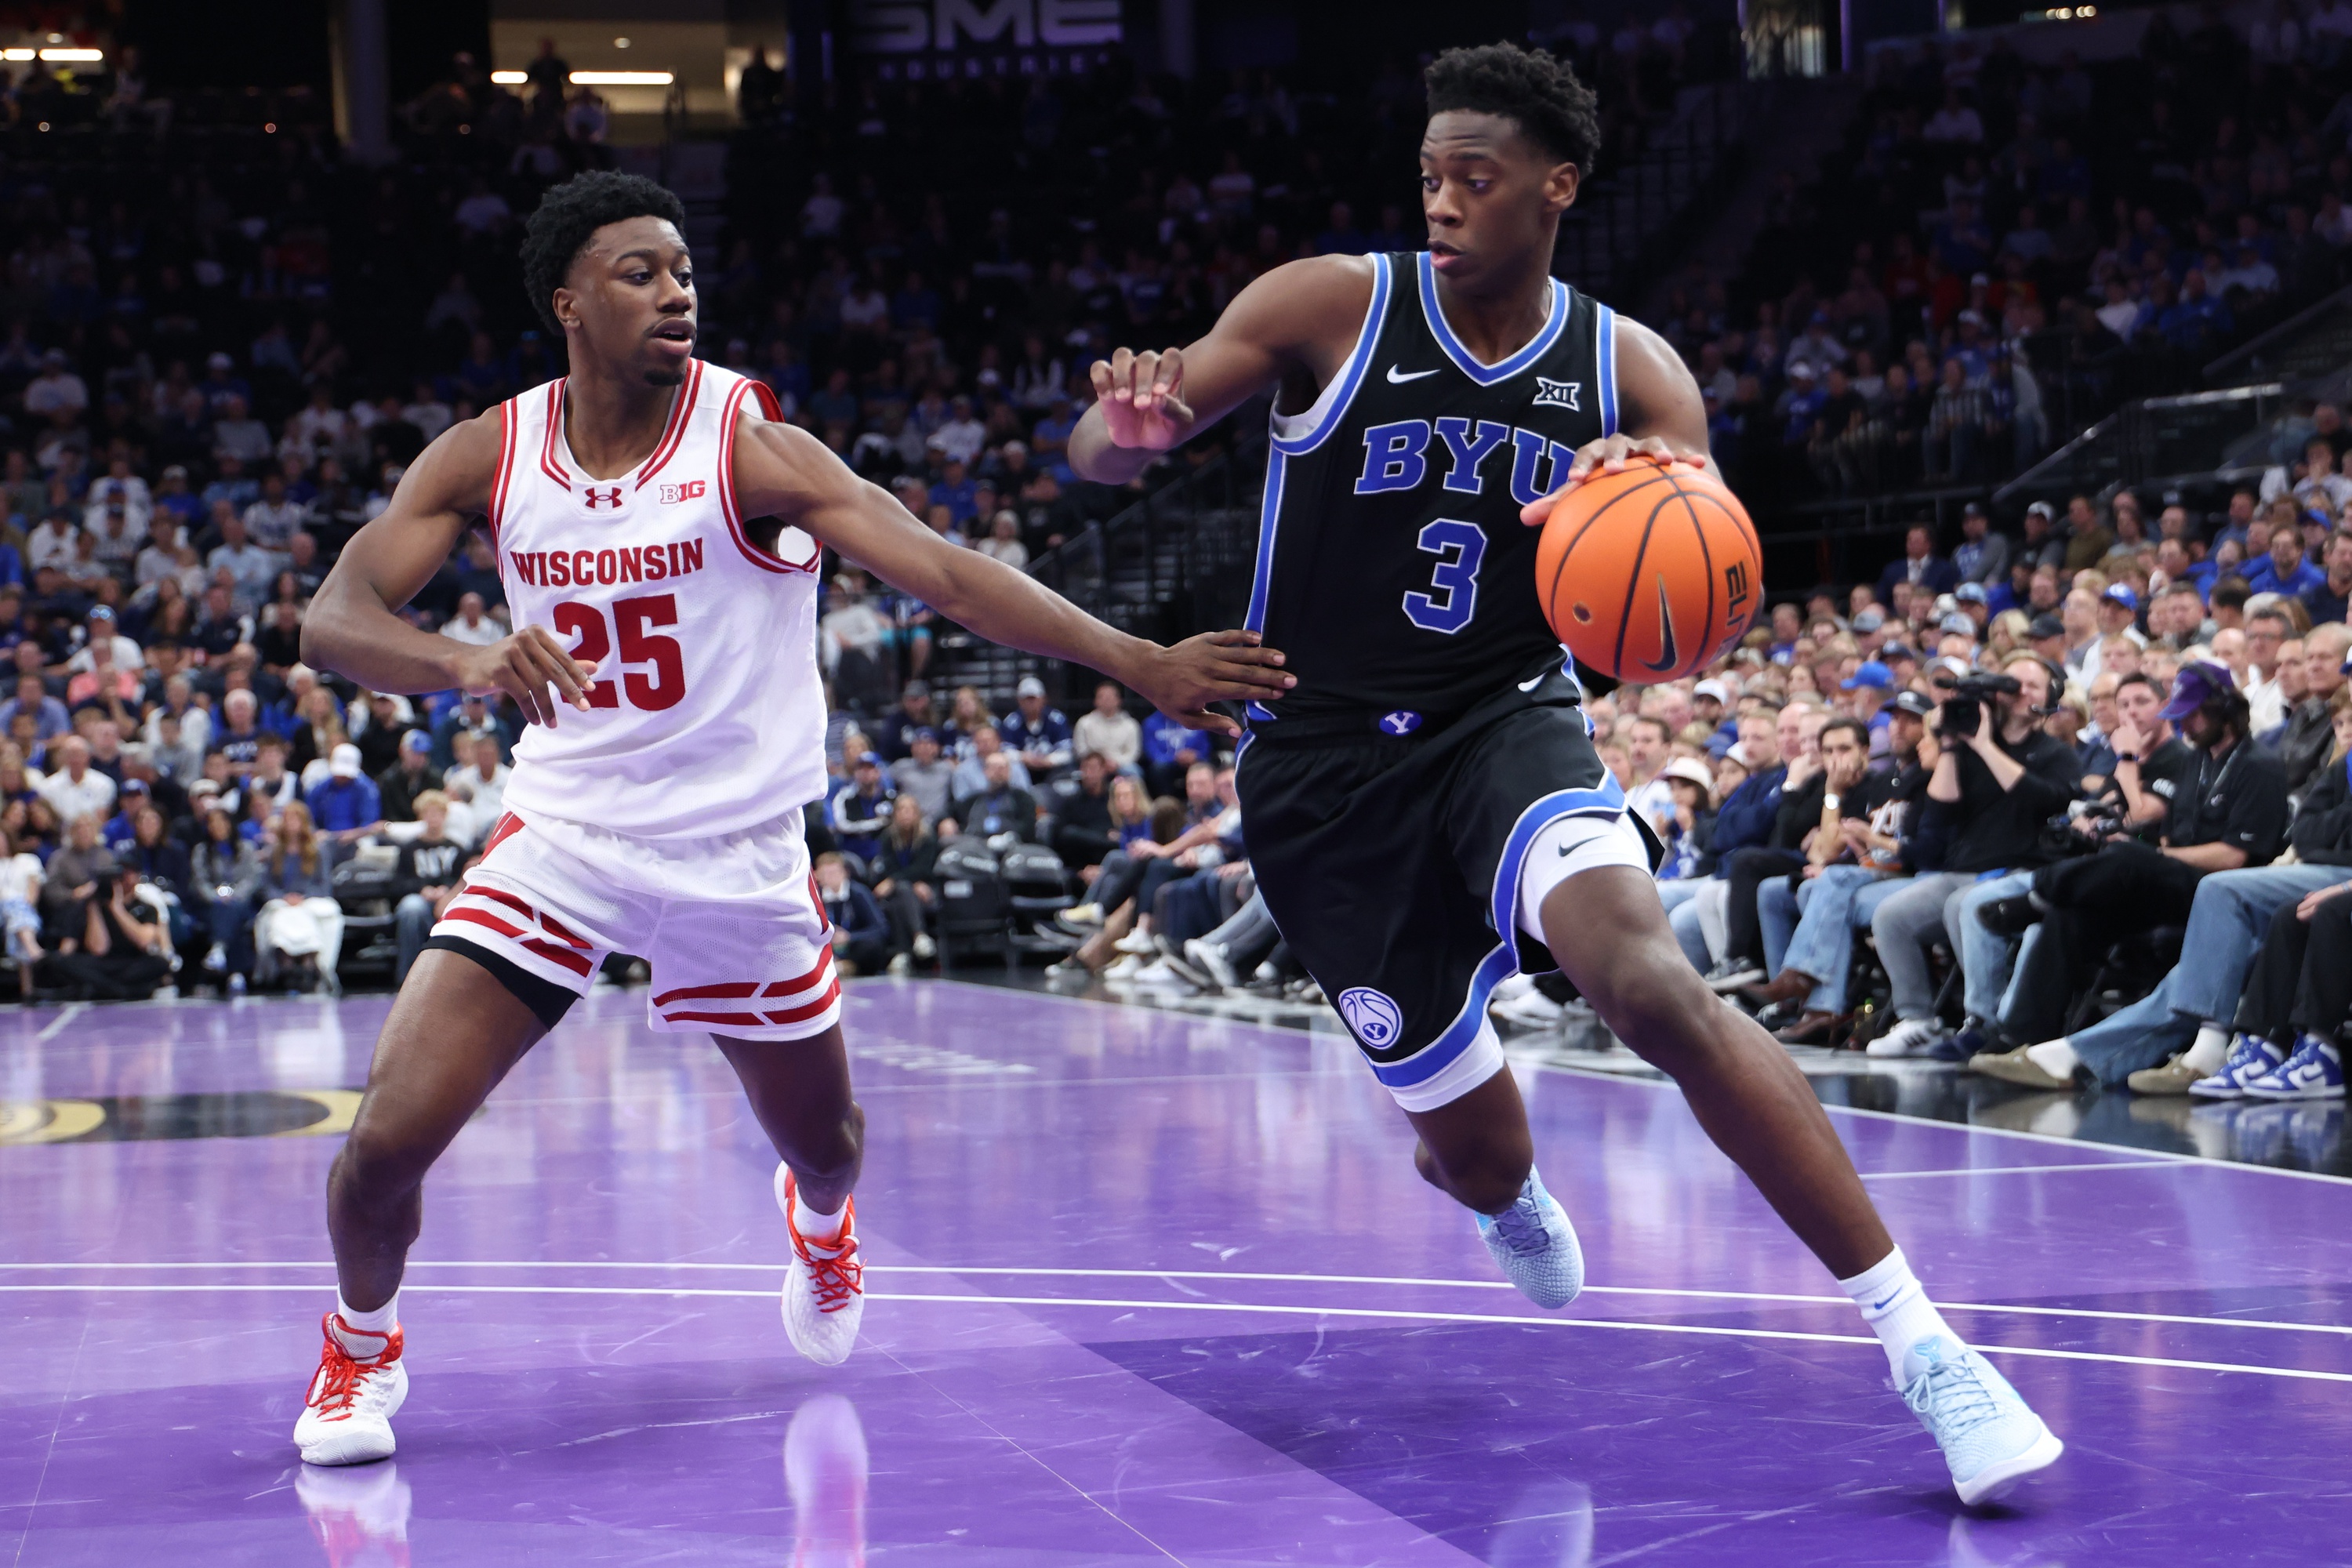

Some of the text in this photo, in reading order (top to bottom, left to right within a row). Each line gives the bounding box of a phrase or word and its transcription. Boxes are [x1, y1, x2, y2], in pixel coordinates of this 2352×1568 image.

[852, 0, 1122, 52] SME
[1354, 417, 1574, 506] BYU
[510, 538, 703, 586] WISCONSIN
[1402, 518, 1487, 634] 3
[553, 593, 685, 711] 25
[1385, 712, 1414, 733] Y
